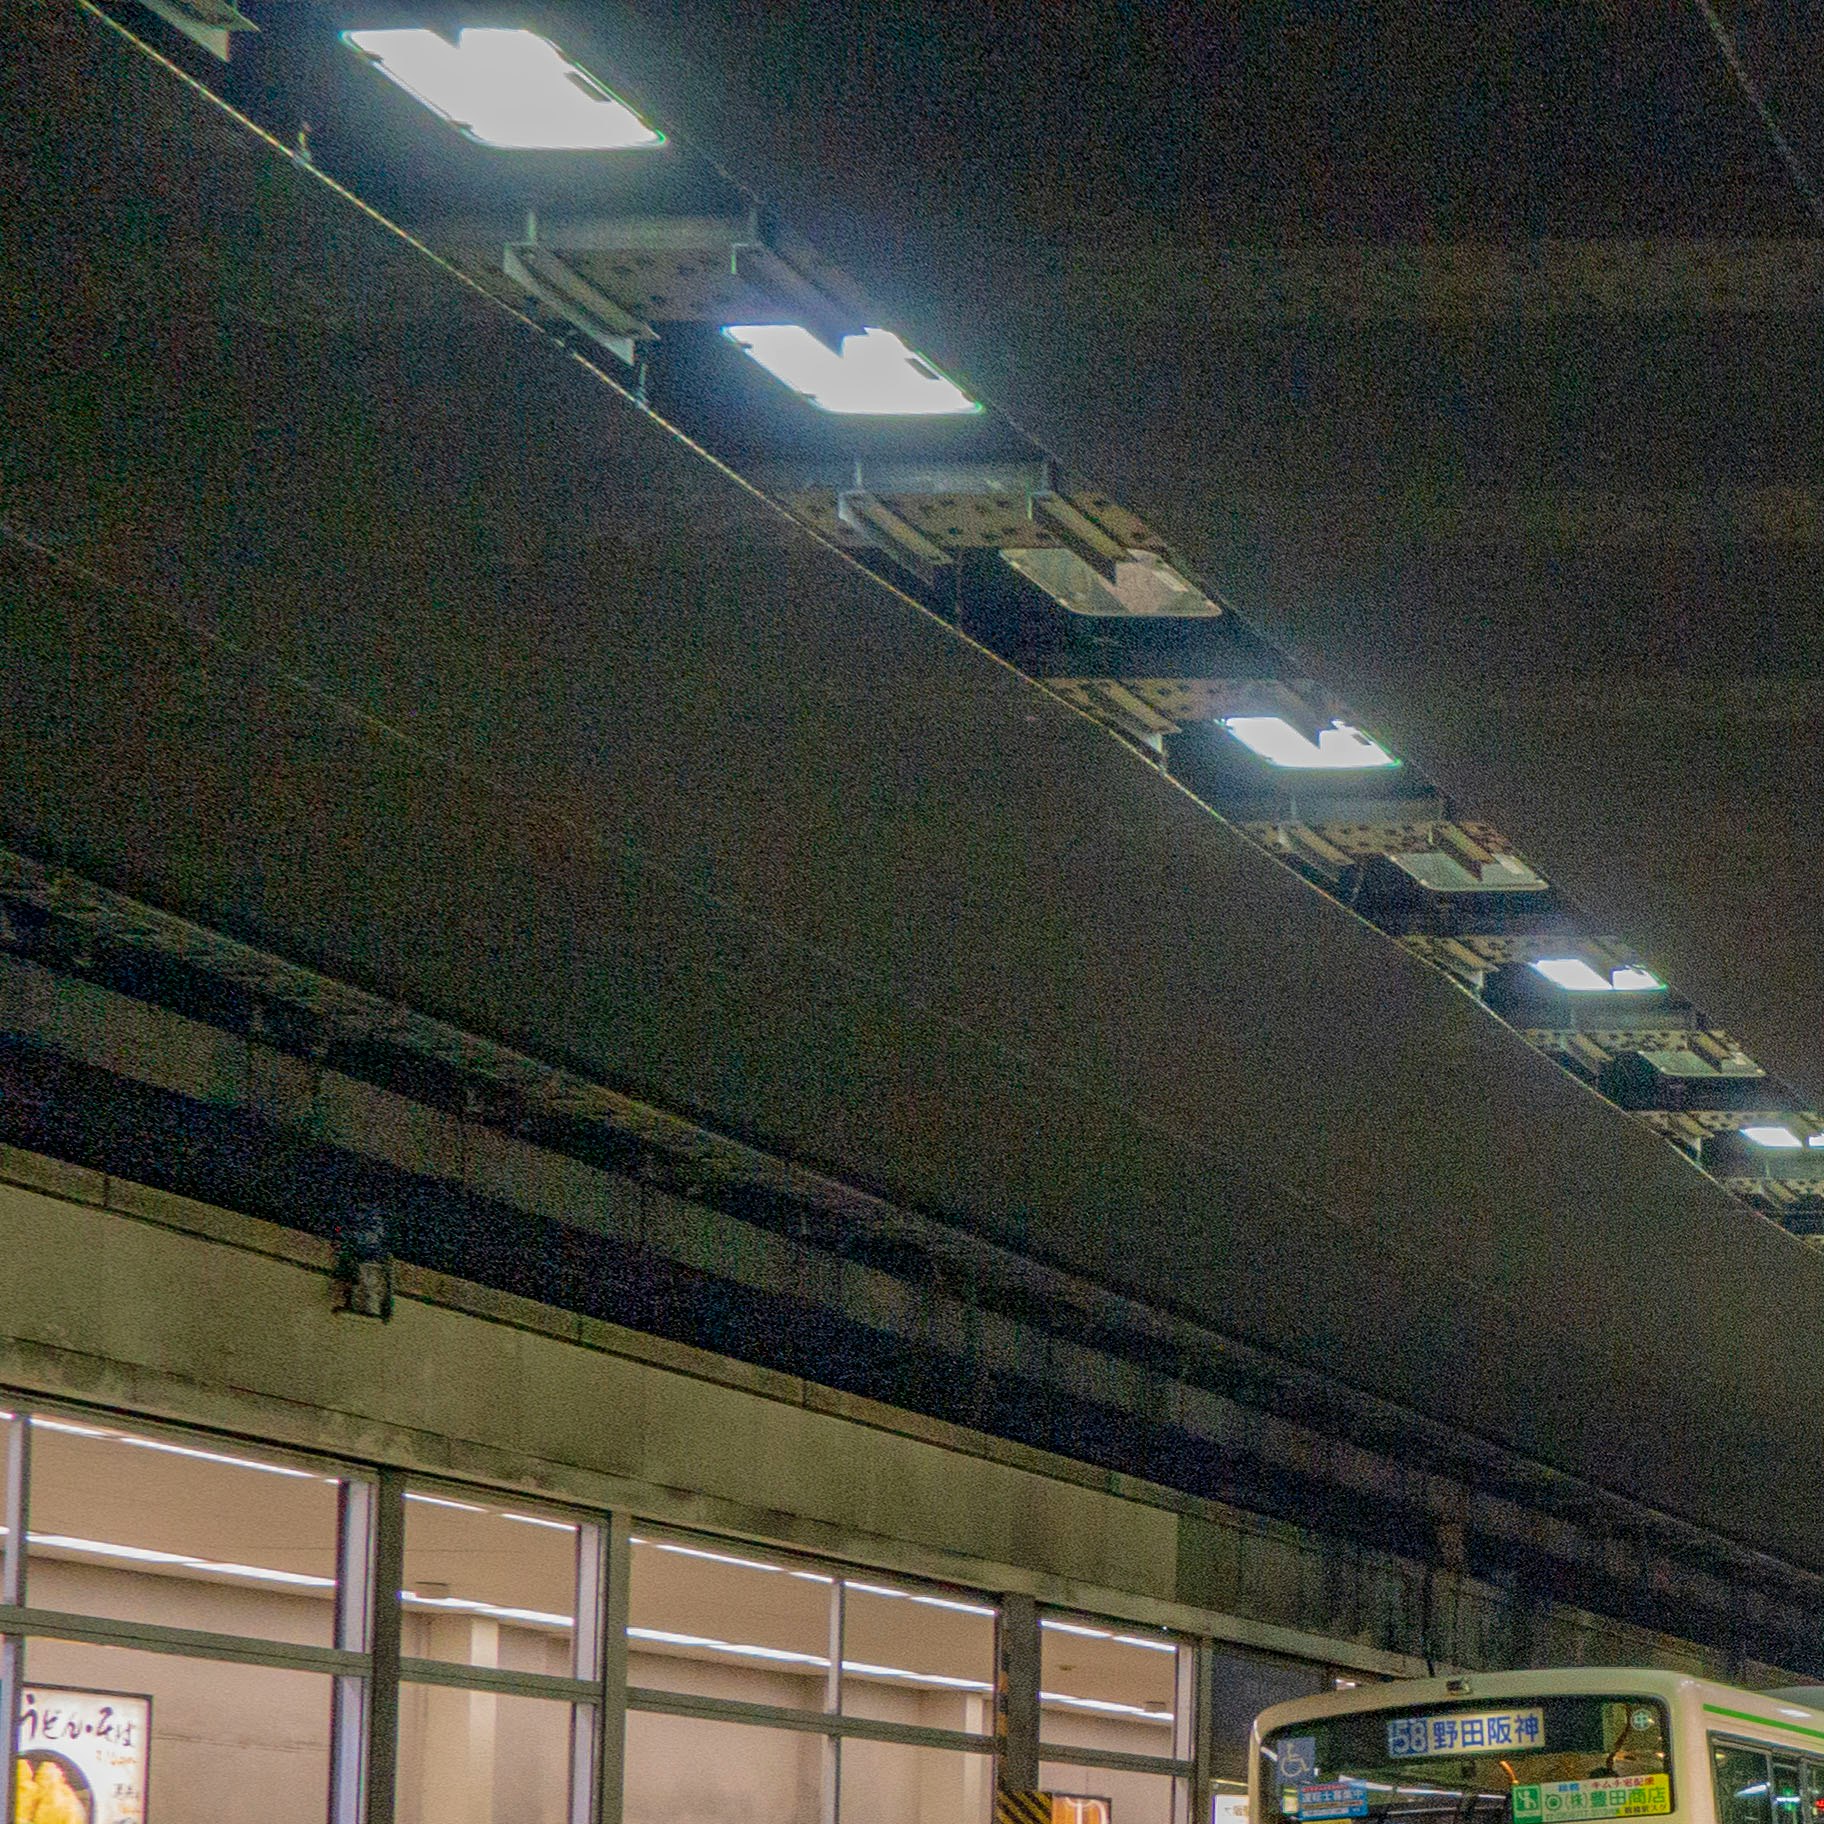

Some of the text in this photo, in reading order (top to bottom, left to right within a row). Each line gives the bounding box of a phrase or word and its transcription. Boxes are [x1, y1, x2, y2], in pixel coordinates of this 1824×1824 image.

[1390, 1713, 1538, 1755] 58 野田阪神
